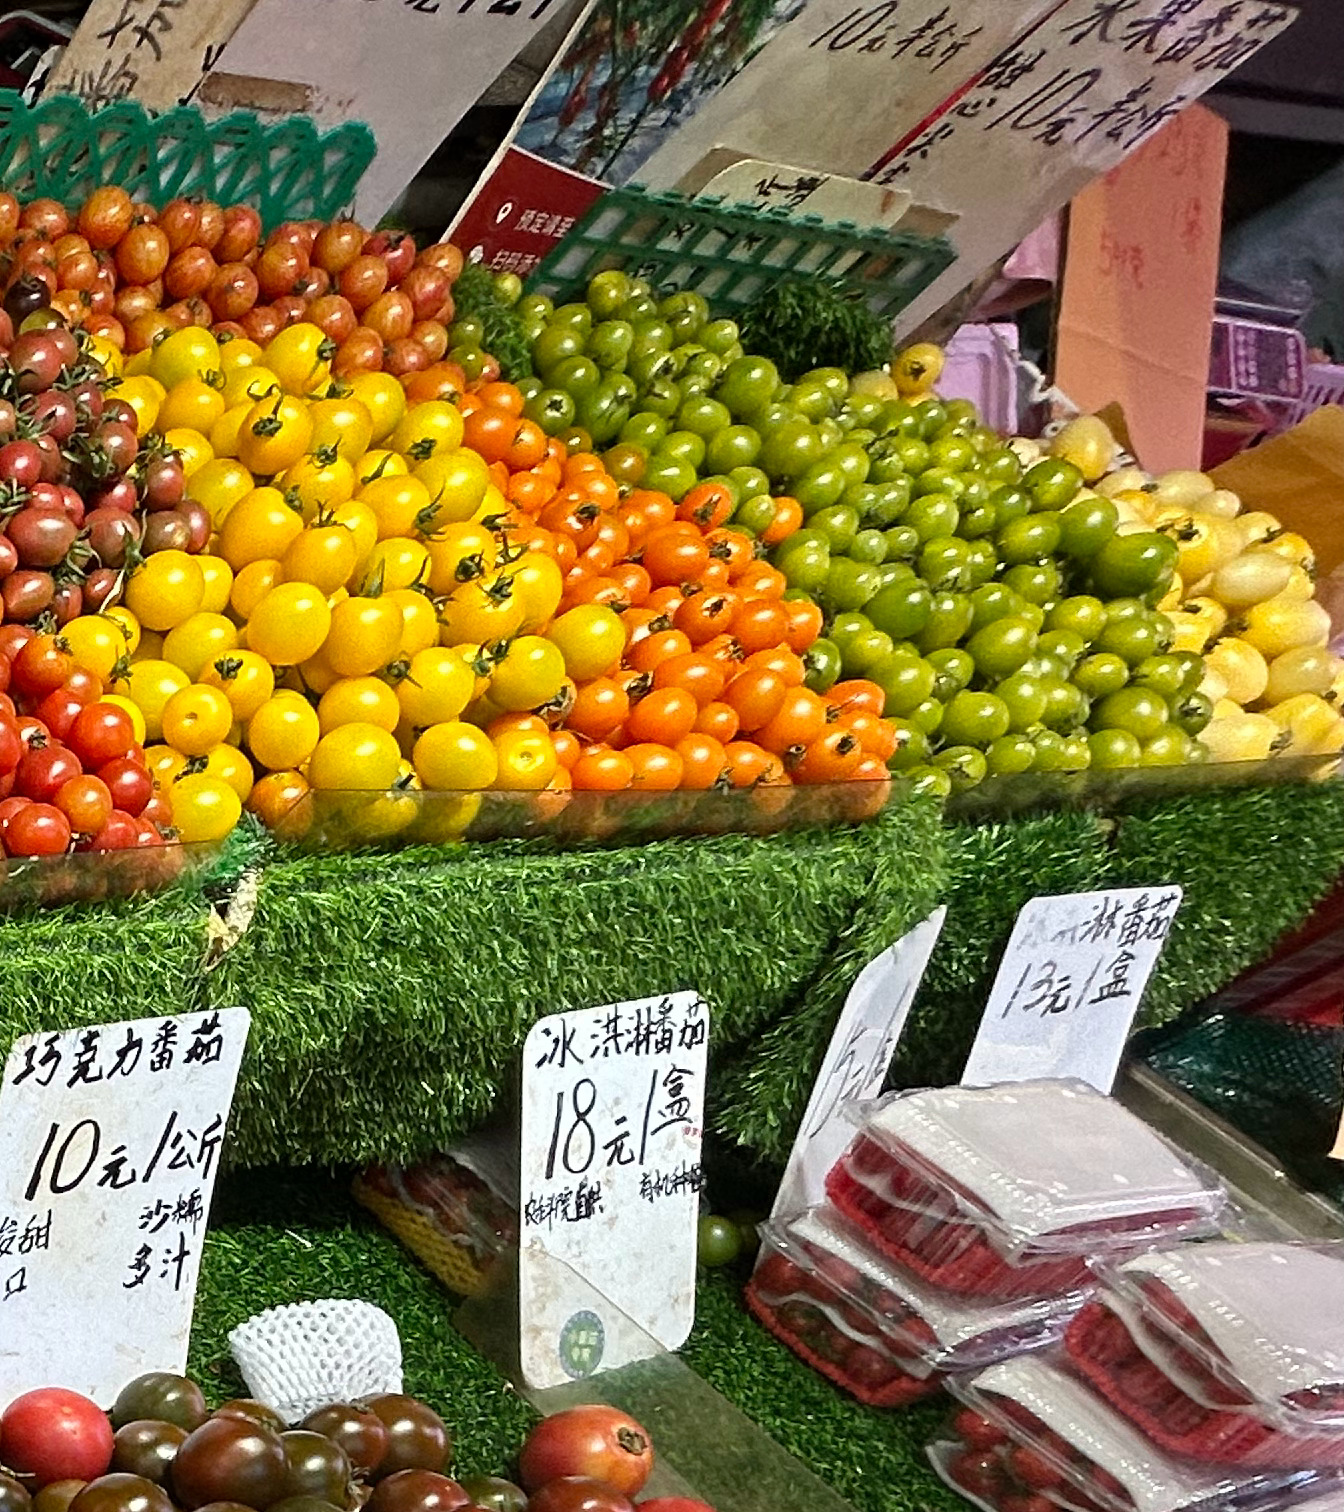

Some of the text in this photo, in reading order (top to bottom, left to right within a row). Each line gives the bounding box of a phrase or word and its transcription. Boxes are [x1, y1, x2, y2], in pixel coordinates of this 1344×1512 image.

[1001, 950, 1136, 1020] 13元/盒
[13, 1013, 223, 1088] 巧克力番茄
[25, 1111, 223, 1201] 10元/公斤
[545, 1064, 694, 1180] 18元/盒
[122, 1233, 191, 1292] 多汁
